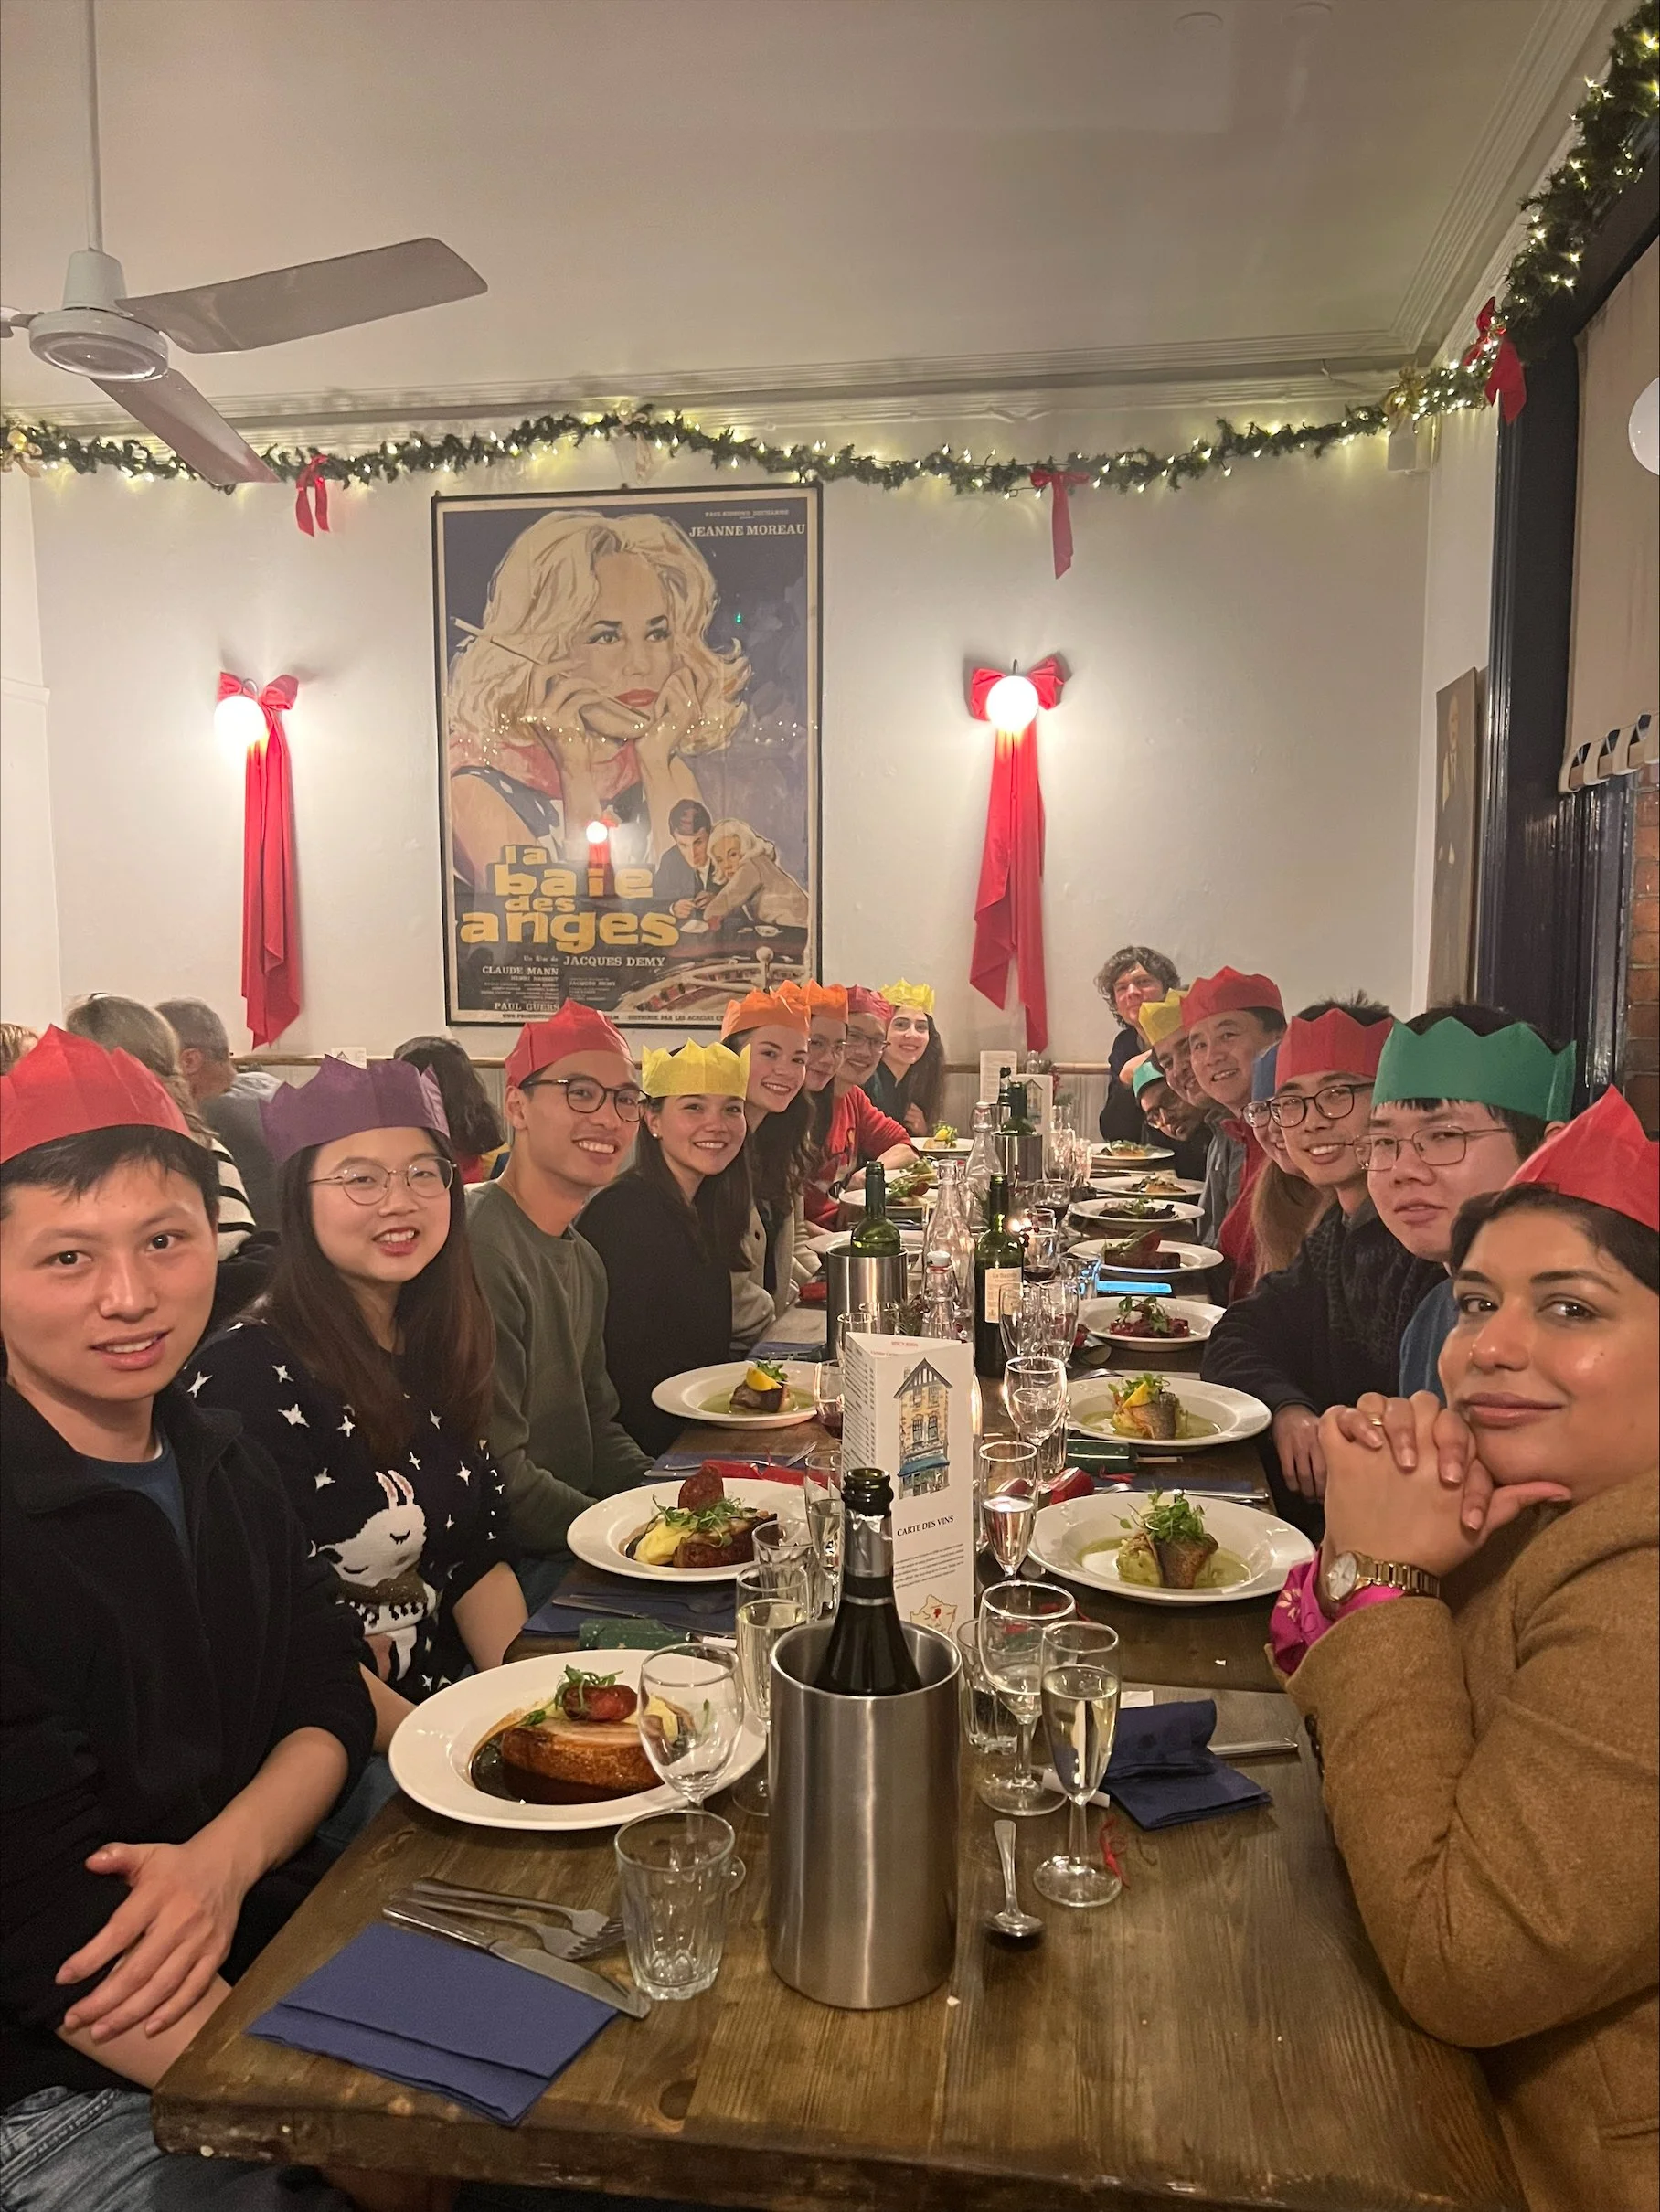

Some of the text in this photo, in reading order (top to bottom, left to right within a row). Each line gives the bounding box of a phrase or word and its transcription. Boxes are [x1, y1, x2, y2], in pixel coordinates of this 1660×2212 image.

[689, 524, 805, 537] JEANNE MOREAU
[505, 845, 548, 866] la
[494, 863, 654, 899] baie
[505, 895, 576, 912] des
[460, 911, 679, 954] anges
[563, 955, 622, 967] JACQUES
[626, 956, 665, 967] DEMY
[482, 965, 559, 975] CLAUDE MANN
[495, 1002, 560, 1012] PAUL GUERS
[897, 1515, 954, 1537] CARTE DES VINS
